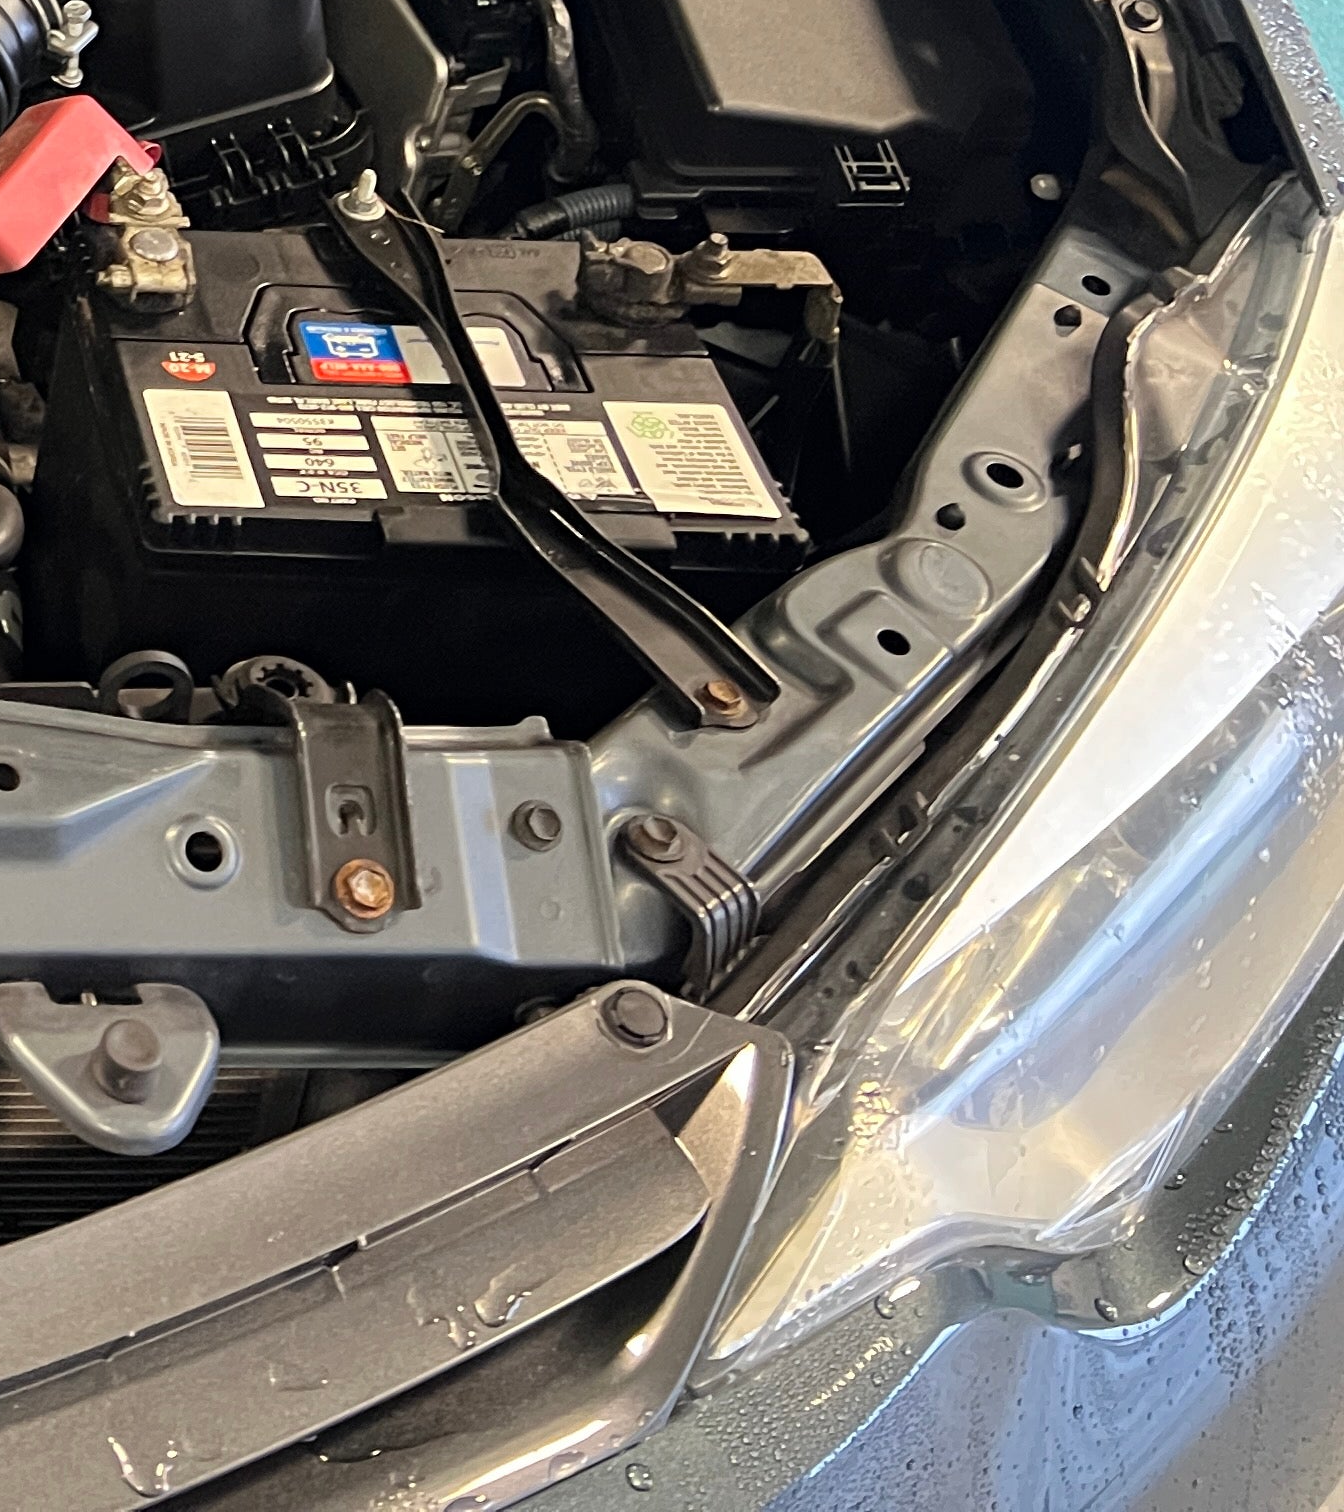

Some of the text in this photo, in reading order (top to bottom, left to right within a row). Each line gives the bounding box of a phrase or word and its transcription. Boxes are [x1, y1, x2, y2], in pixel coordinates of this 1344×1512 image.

[302, 437, 323, 446] 95
[304, 457, 335, 467] 640
[296, 481, 363, 494] 35N-C
